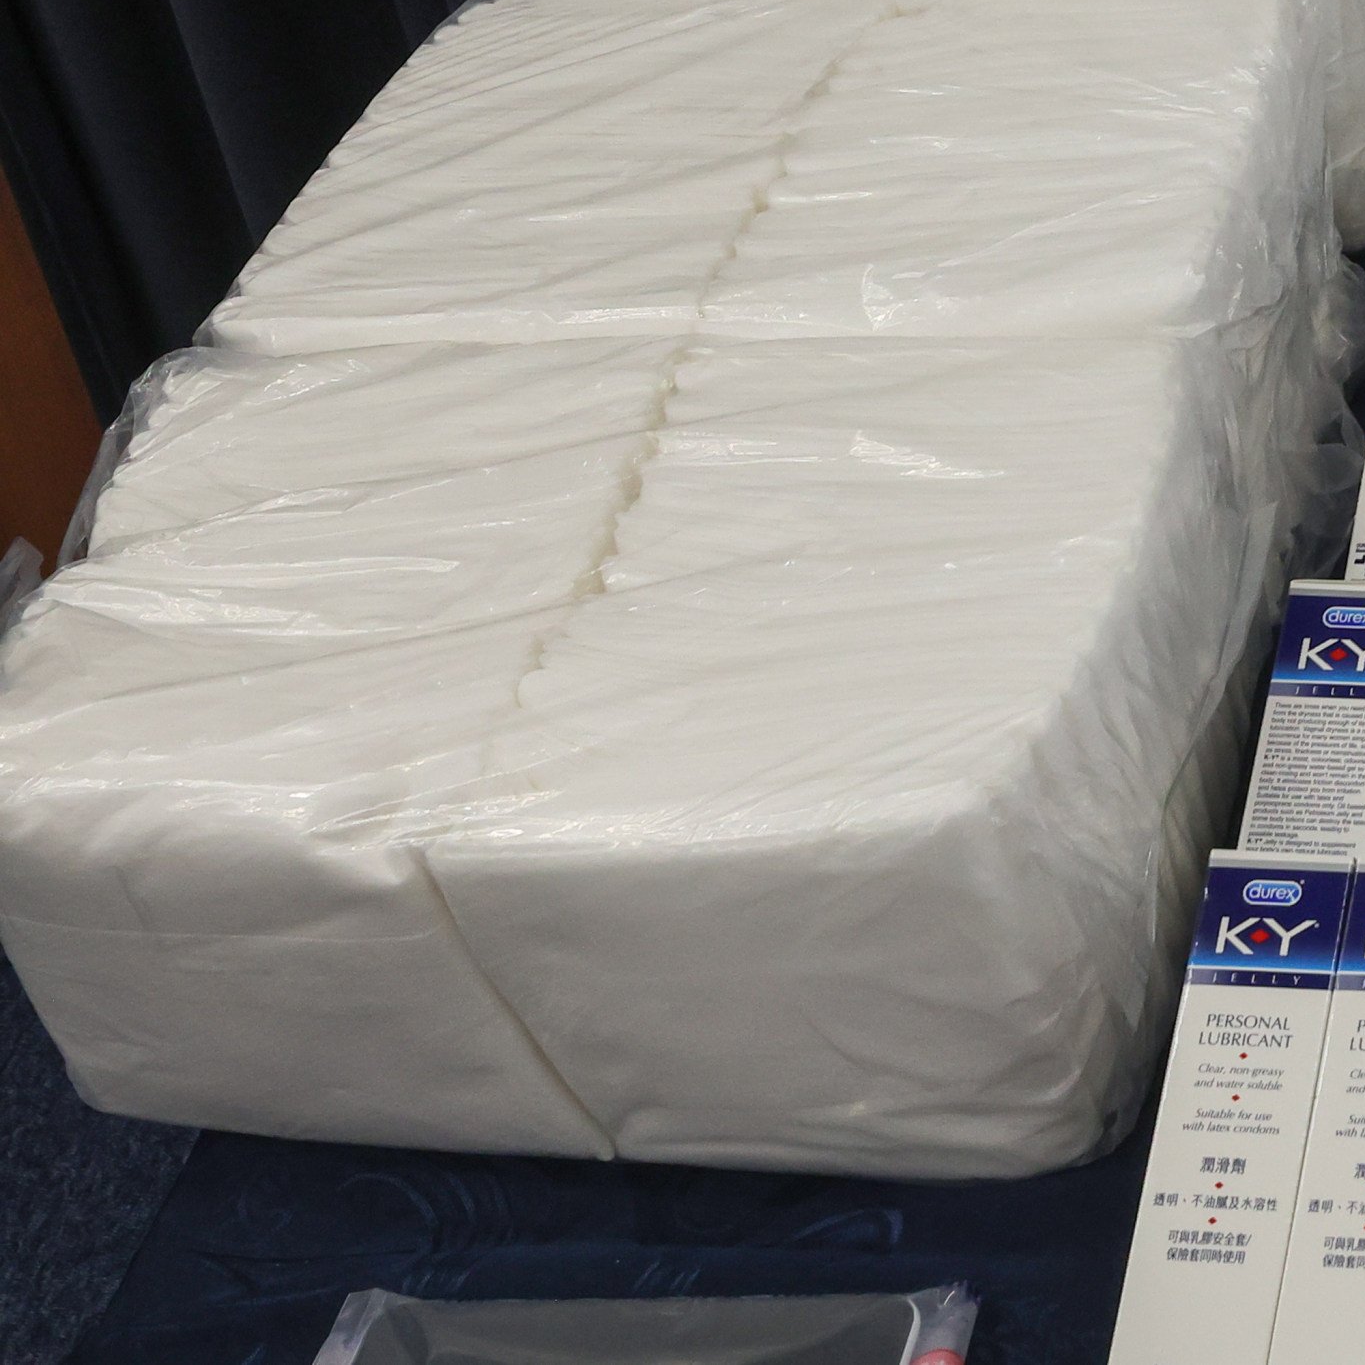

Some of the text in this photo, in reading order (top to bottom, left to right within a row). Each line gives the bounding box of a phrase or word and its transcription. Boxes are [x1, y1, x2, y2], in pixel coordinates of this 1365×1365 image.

[1247, 882, 1298, 904] durex
[1213, 972, 1301, 985] JELLY
[1206, 1013, 1291, 1030] PERSONAL
[1198, 1031, 1294, 1048] LUBRICANT
[1229, 1066, 1284, 1077] non-greasy
[1194, 1078, 1283, 1091] and water soluble
[1195, 1108, 1273, 1121] Suitable for use
[1182, 1121, 1280, 1135] with latex condoms
[1200, 1156, 1247, 1175] 潤滑劑
